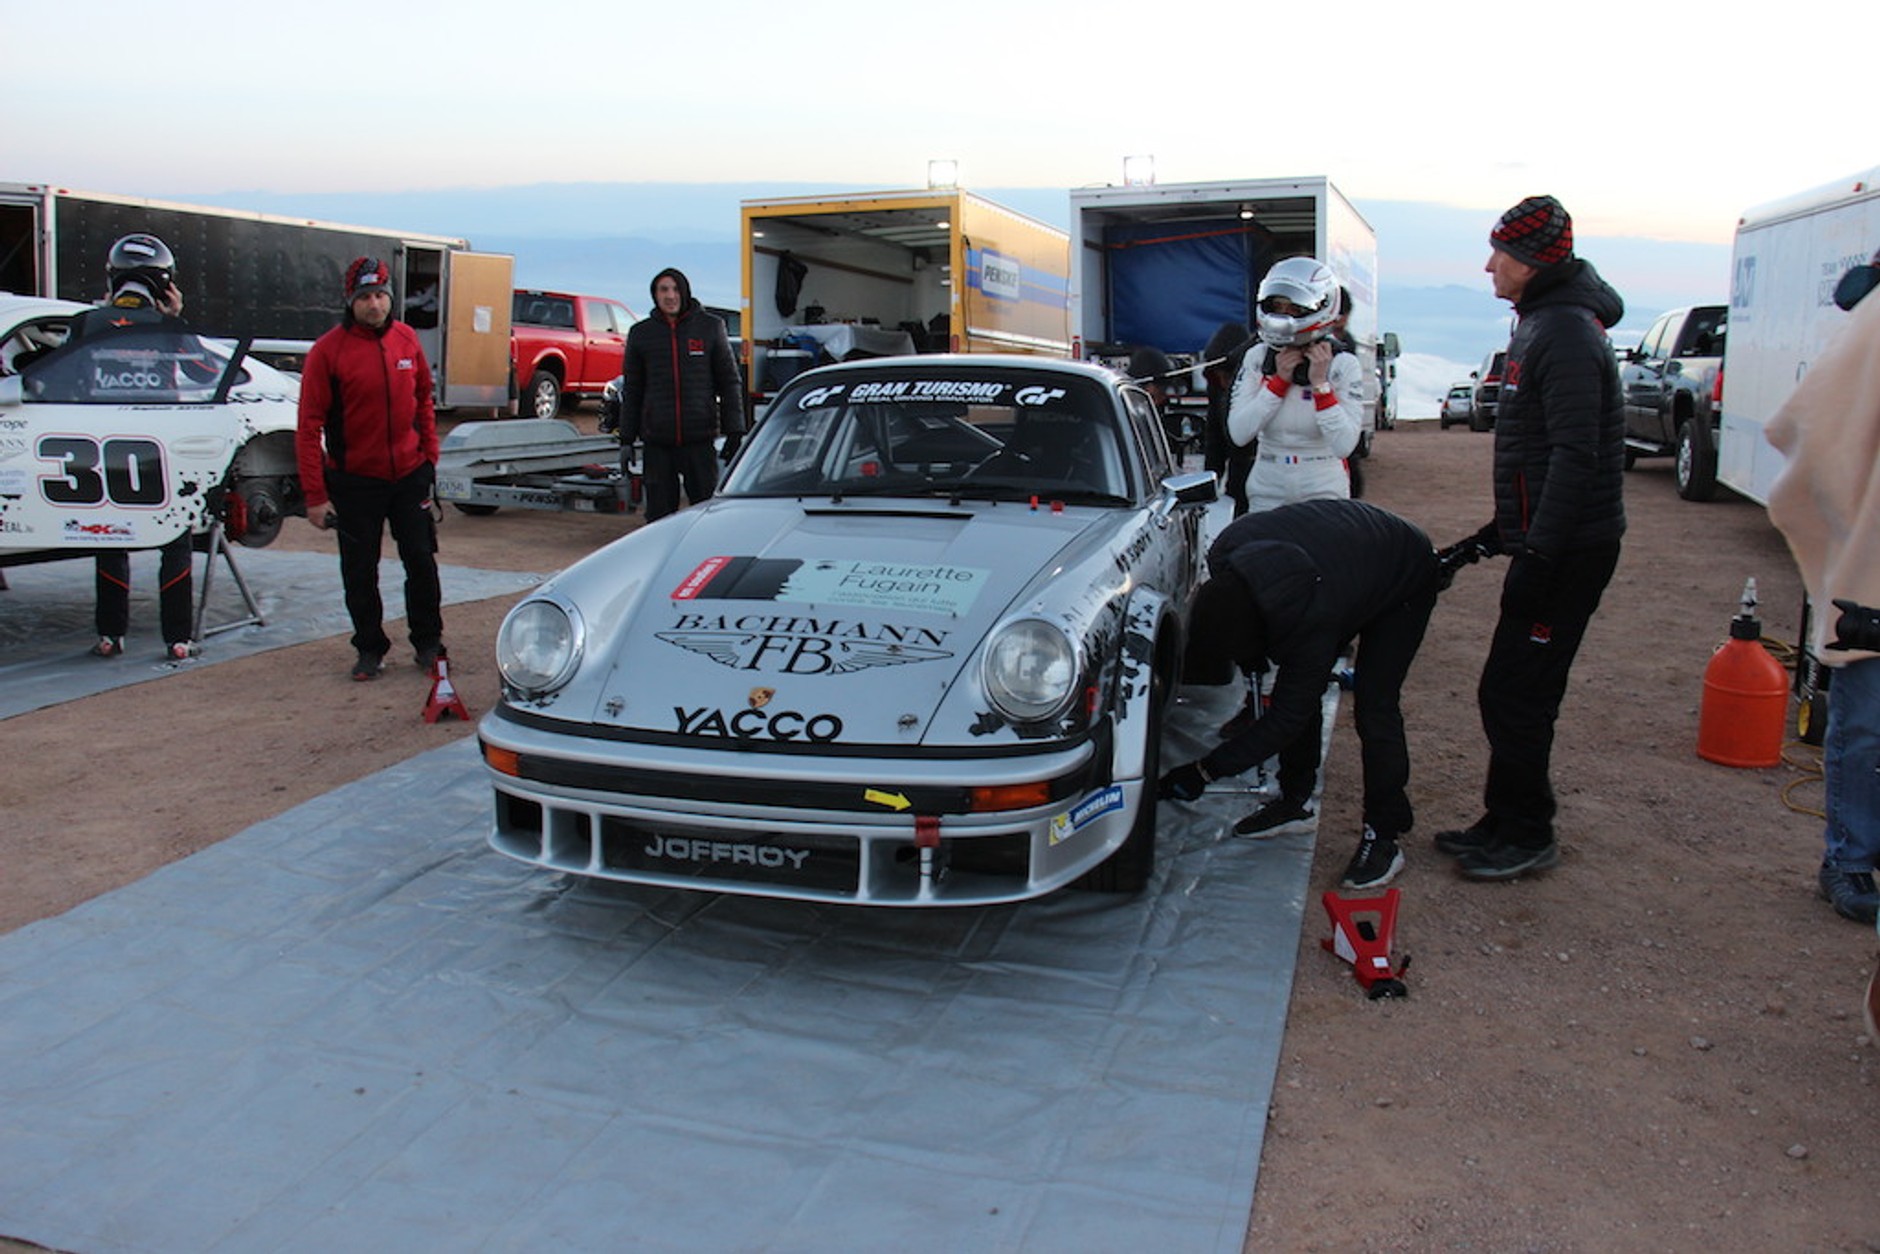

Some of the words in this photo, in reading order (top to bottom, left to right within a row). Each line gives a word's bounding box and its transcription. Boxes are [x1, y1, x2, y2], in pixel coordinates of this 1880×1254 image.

[97, 371, 161, 388] YACCO
[850, 382, 910, 398] GRAN
[911, 381, 1004, 398] TURISMO
[35, 434, 170, 508] 30
[838, 574, 942, 594] Fugain
[849, 562, 974, 582] Laurette
[670, 613, 954, 647] BACHMANN
[740, 633, 834, 676] FB
[673, 706, 844, 742] YACCO
[1074, 791, 1121, 822] MICHELIN
[644, 834, 811, 870] JOFFROY
